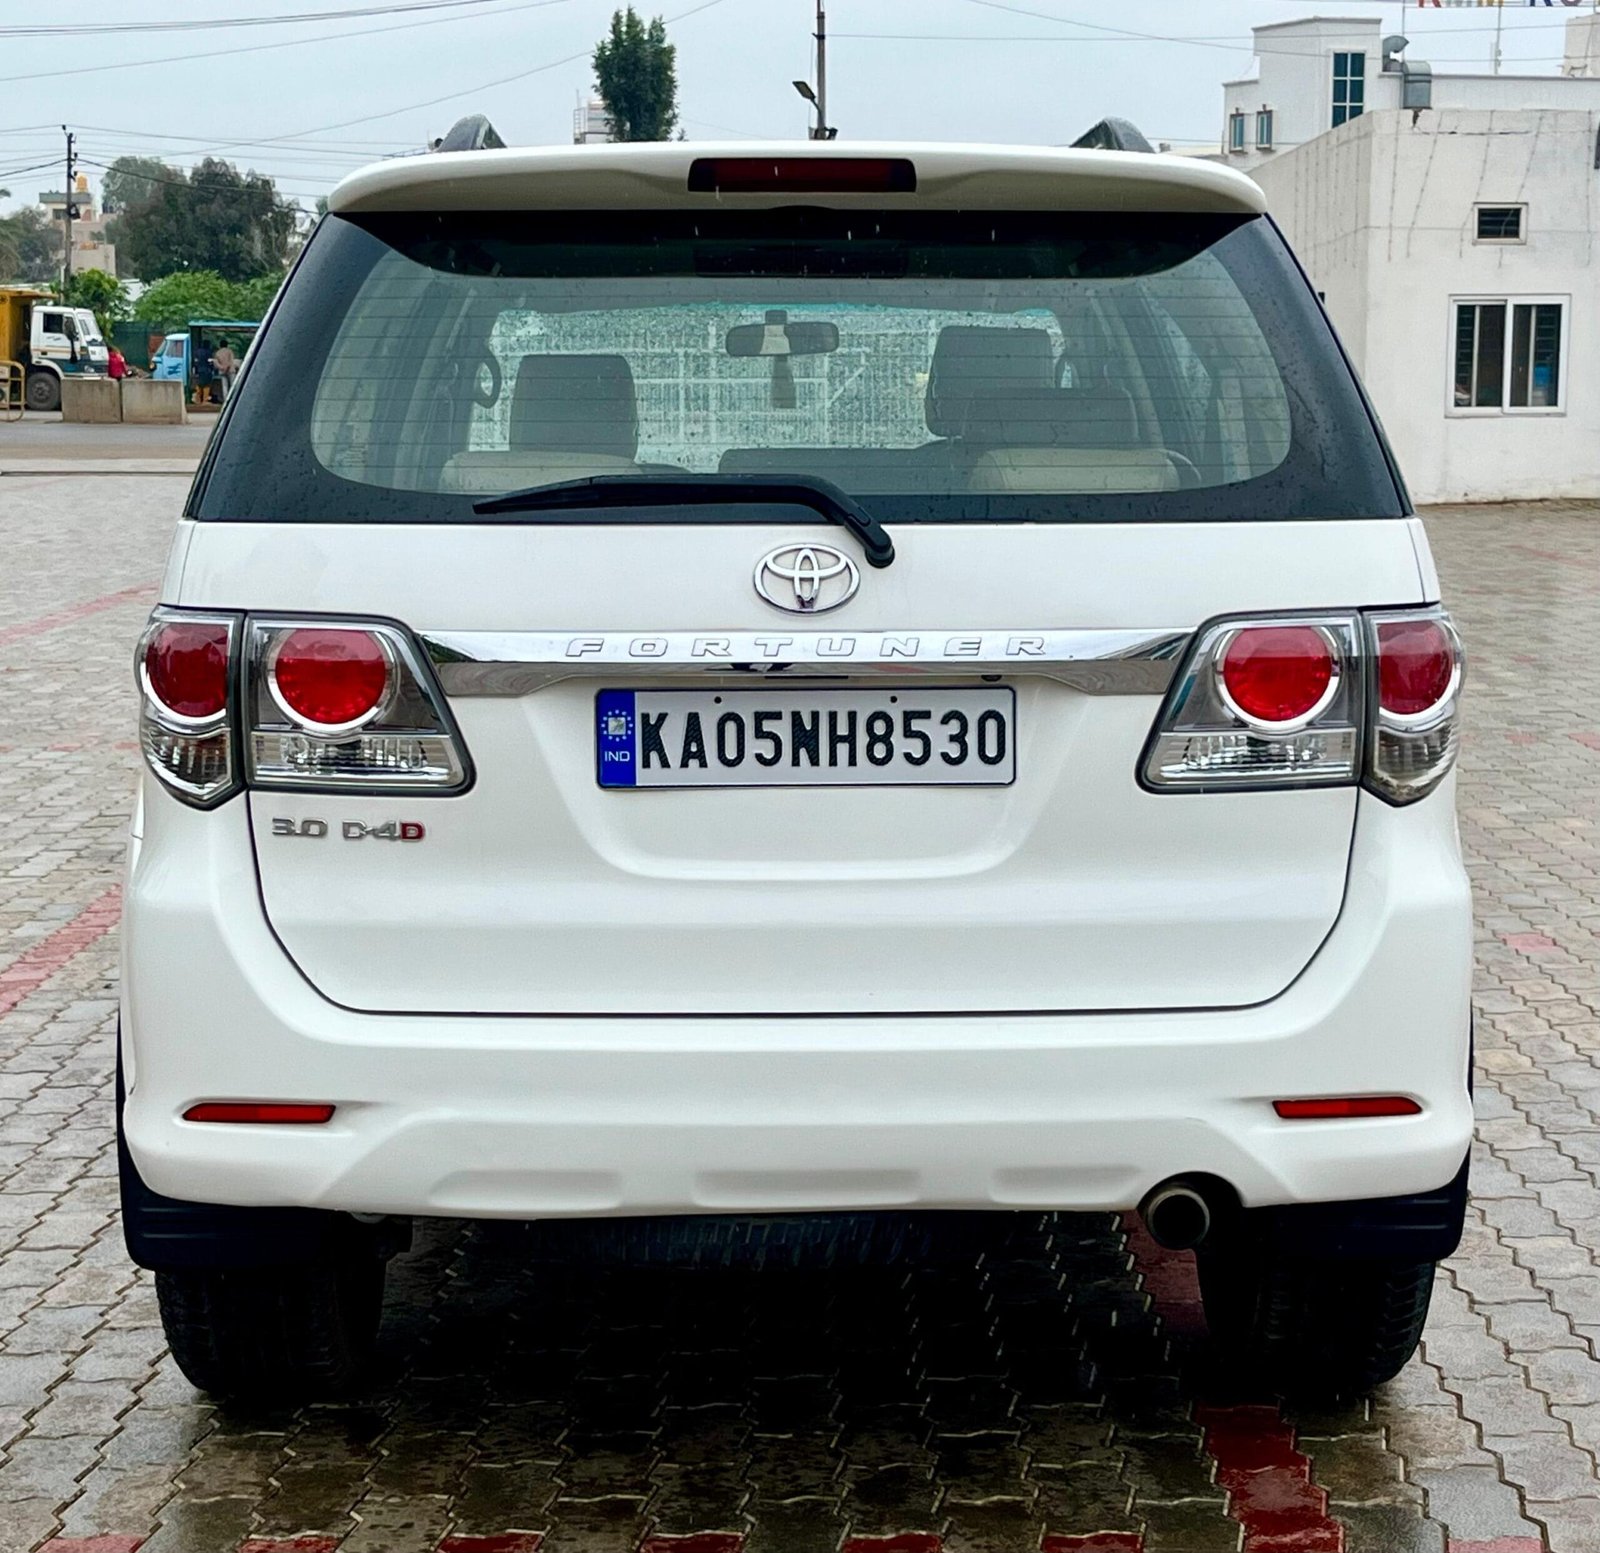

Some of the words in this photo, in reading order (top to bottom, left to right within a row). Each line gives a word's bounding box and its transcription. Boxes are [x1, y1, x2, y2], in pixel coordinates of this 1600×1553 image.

[565, 637, 1046, 657] FORTUNER
[641, 709, 1006, 769] KA05NH8530
[604, 751, 630, 762] IND
[272, 817, 328, 836] 3.0
[342, 820, 425, 842] D-4D
